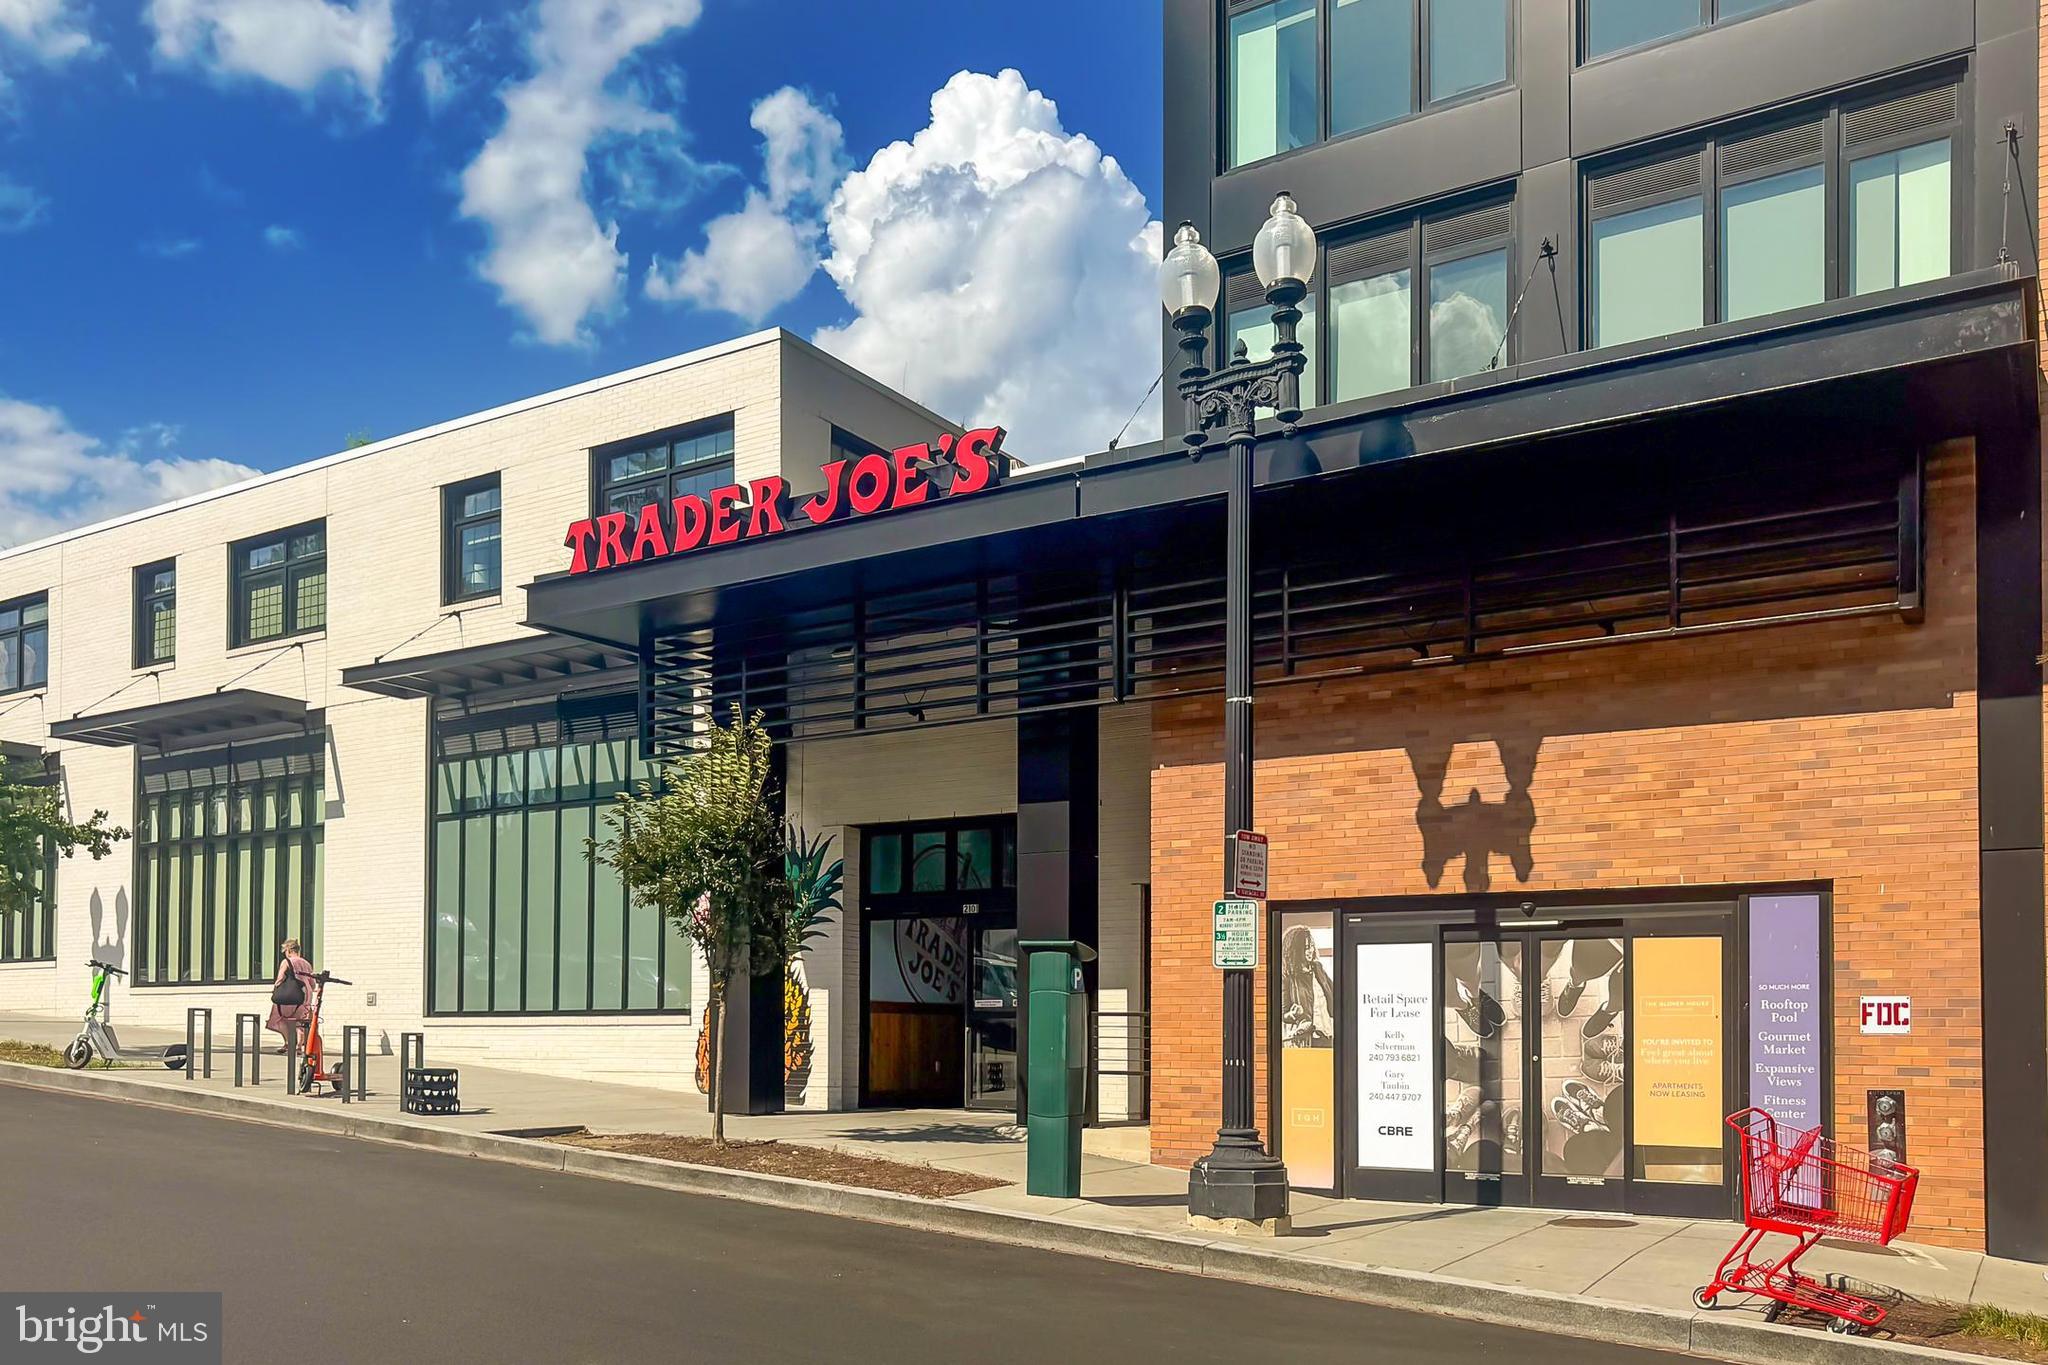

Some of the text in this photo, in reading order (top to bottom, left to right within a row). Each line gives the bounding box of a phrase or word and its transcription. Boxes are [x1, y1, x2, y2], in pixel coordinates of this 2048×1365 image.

[564, 425, 1008, 575] TRADER JOE'S
[1218, 905, 1224, 915] 2
[1074, 968, 1081, 989] P
[1791, 983, 1810, 991] MORE
[1363, 993, 1428, 1007] Retail Space
[1761, 999, 1808, 1013] Rooftop
[1370, 1007, 1420, 1018] For Lease
[1771, 1011, 1797, 1023] Pool
[1861, 1002, 1909, 1026] FDC
[1384, 1031, 1405, 1041] Kelly
[1758, 1031, 1811, 1042] Gourmet
[1374, 1042, 1415, 1051] Silverman
[1764, 1043, 1806, 1055] Market
[1384, 1070, 1405, 1081] Gary
[1755, 1063, 1815, 1077] Expansive
[1652, 1082, 1704, 1090] APARTMENTS
[1767, 1076, 1802, 1087] Views
[1763, 1094, 1806, 1106] Fitness
[1378, 1125, 1414, 1137] CBRE
